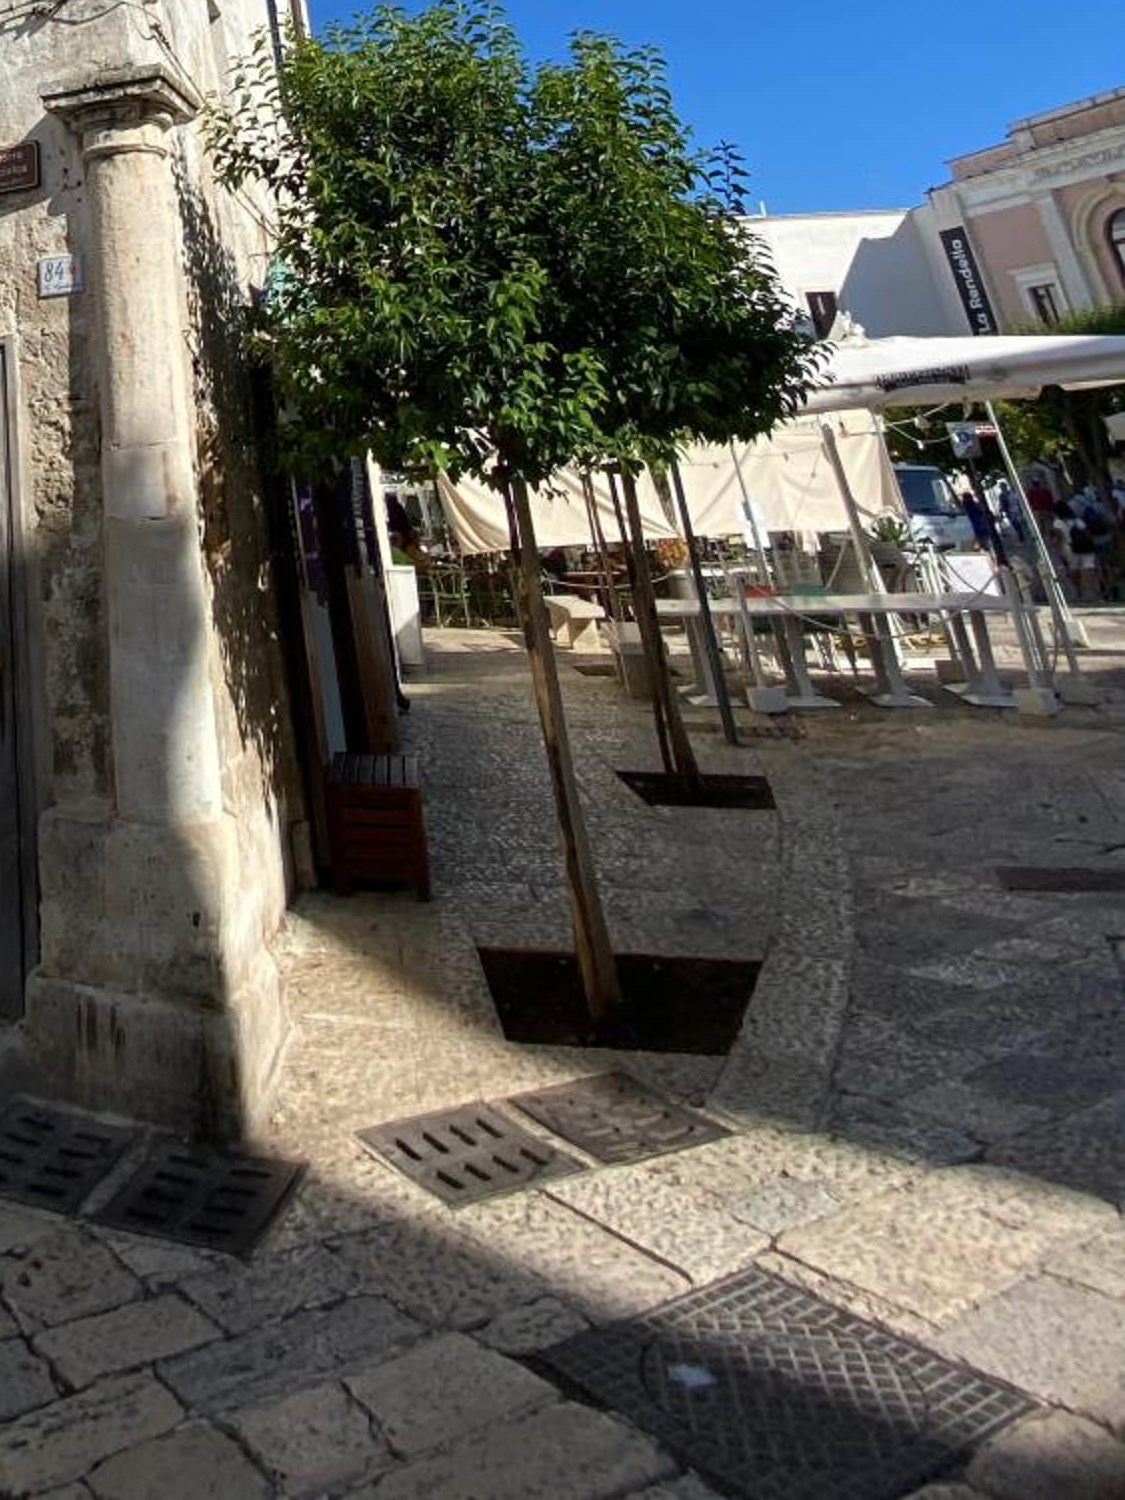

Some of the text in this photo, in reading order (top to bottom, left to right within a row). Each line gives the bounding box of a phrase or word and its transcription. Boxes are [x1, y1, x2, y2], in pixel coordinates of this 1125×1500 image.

[44, 260, 64, 283] 84
[950, 239, 991, 333] La Rendella
